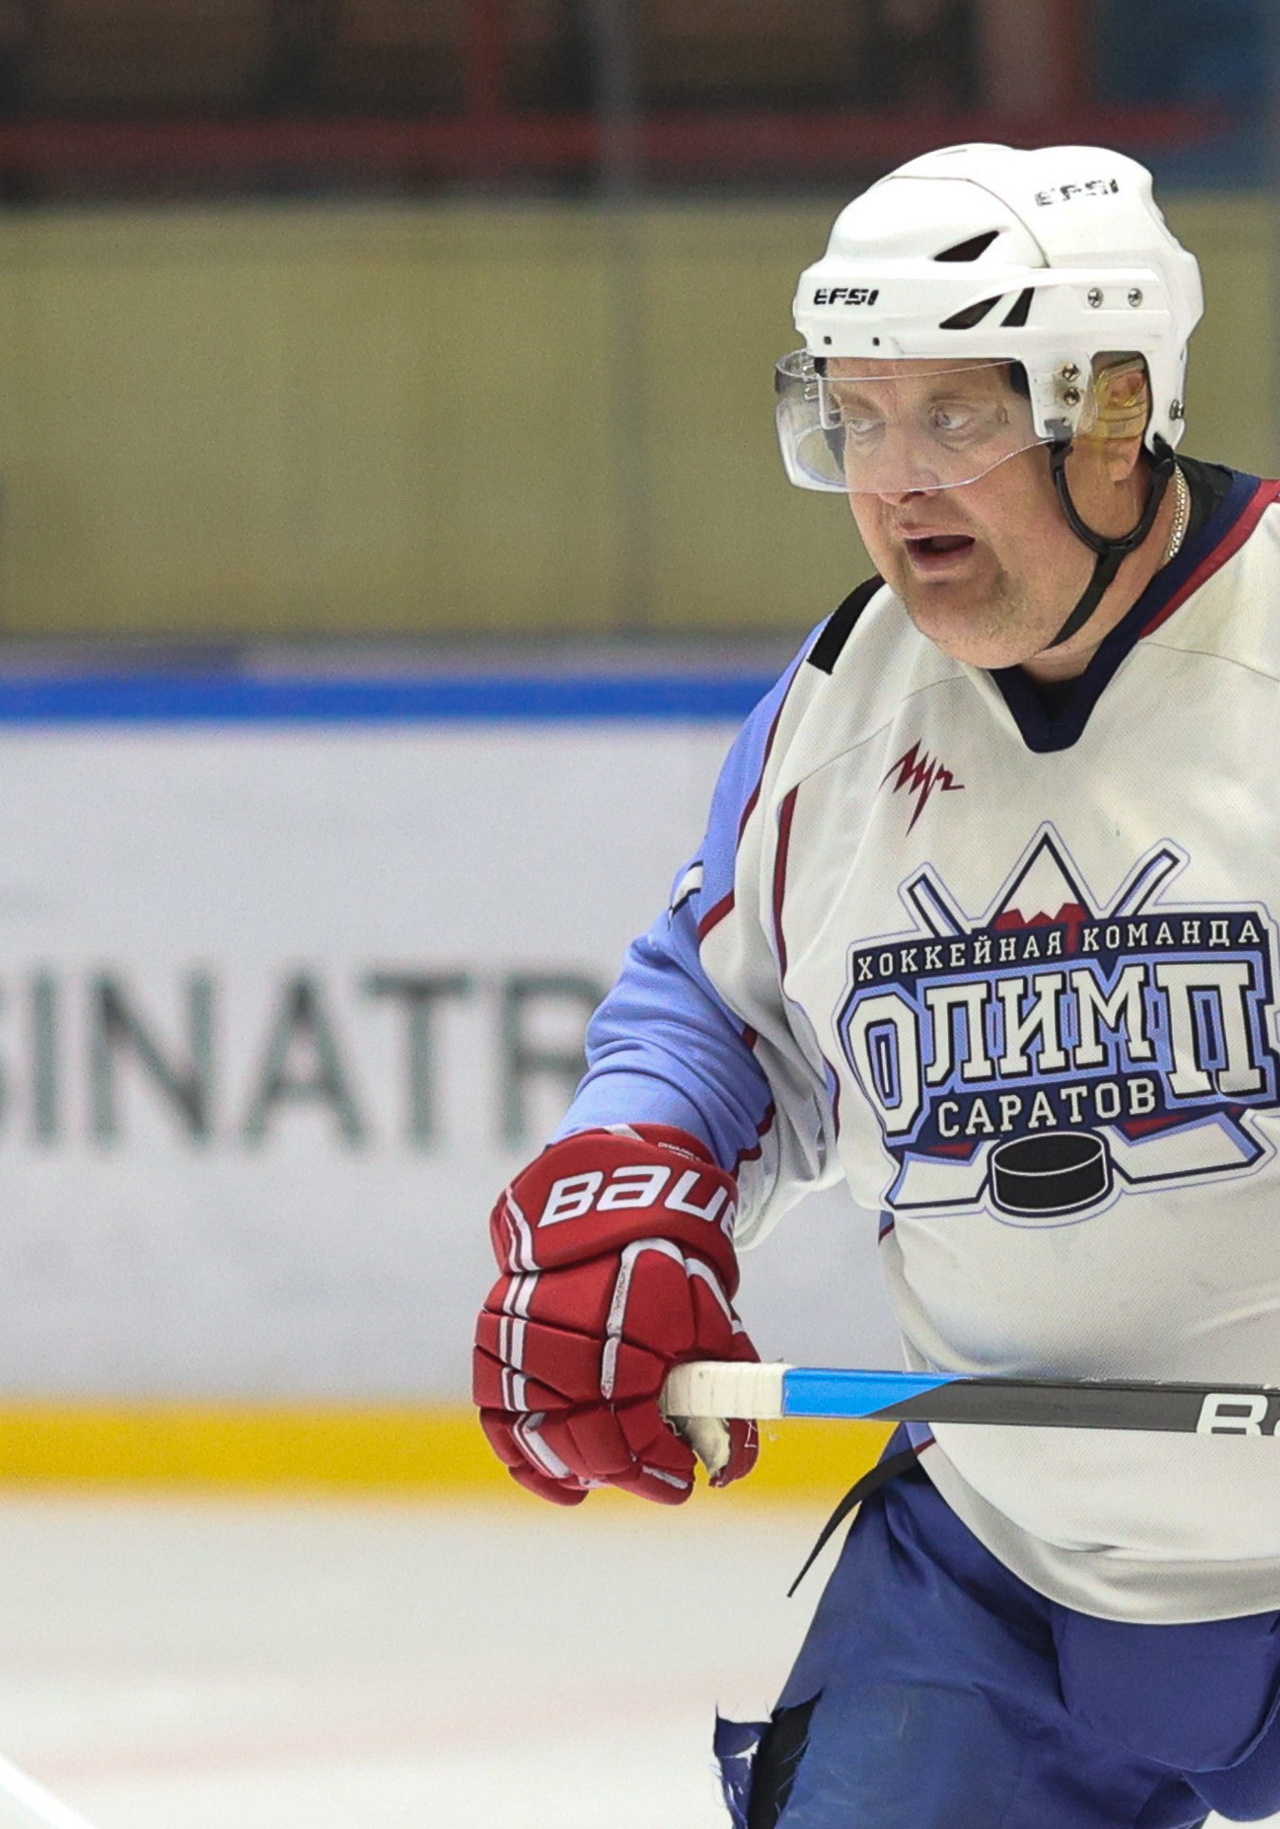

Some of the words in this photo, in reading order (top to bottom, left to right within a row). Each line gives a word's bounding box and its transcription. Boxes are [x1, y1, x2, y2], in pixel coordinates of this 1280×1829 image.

[813, 288, 879, 306] EFSI
[857, 930, 1063, 982] ХОККЕЙНАЯ
[1082, 917, 1261, 952] КОМАНДА
[847, 960, 1264, 1138] ОЛИМП
[936, 1077, 1157, 1138] САРАТОВ
